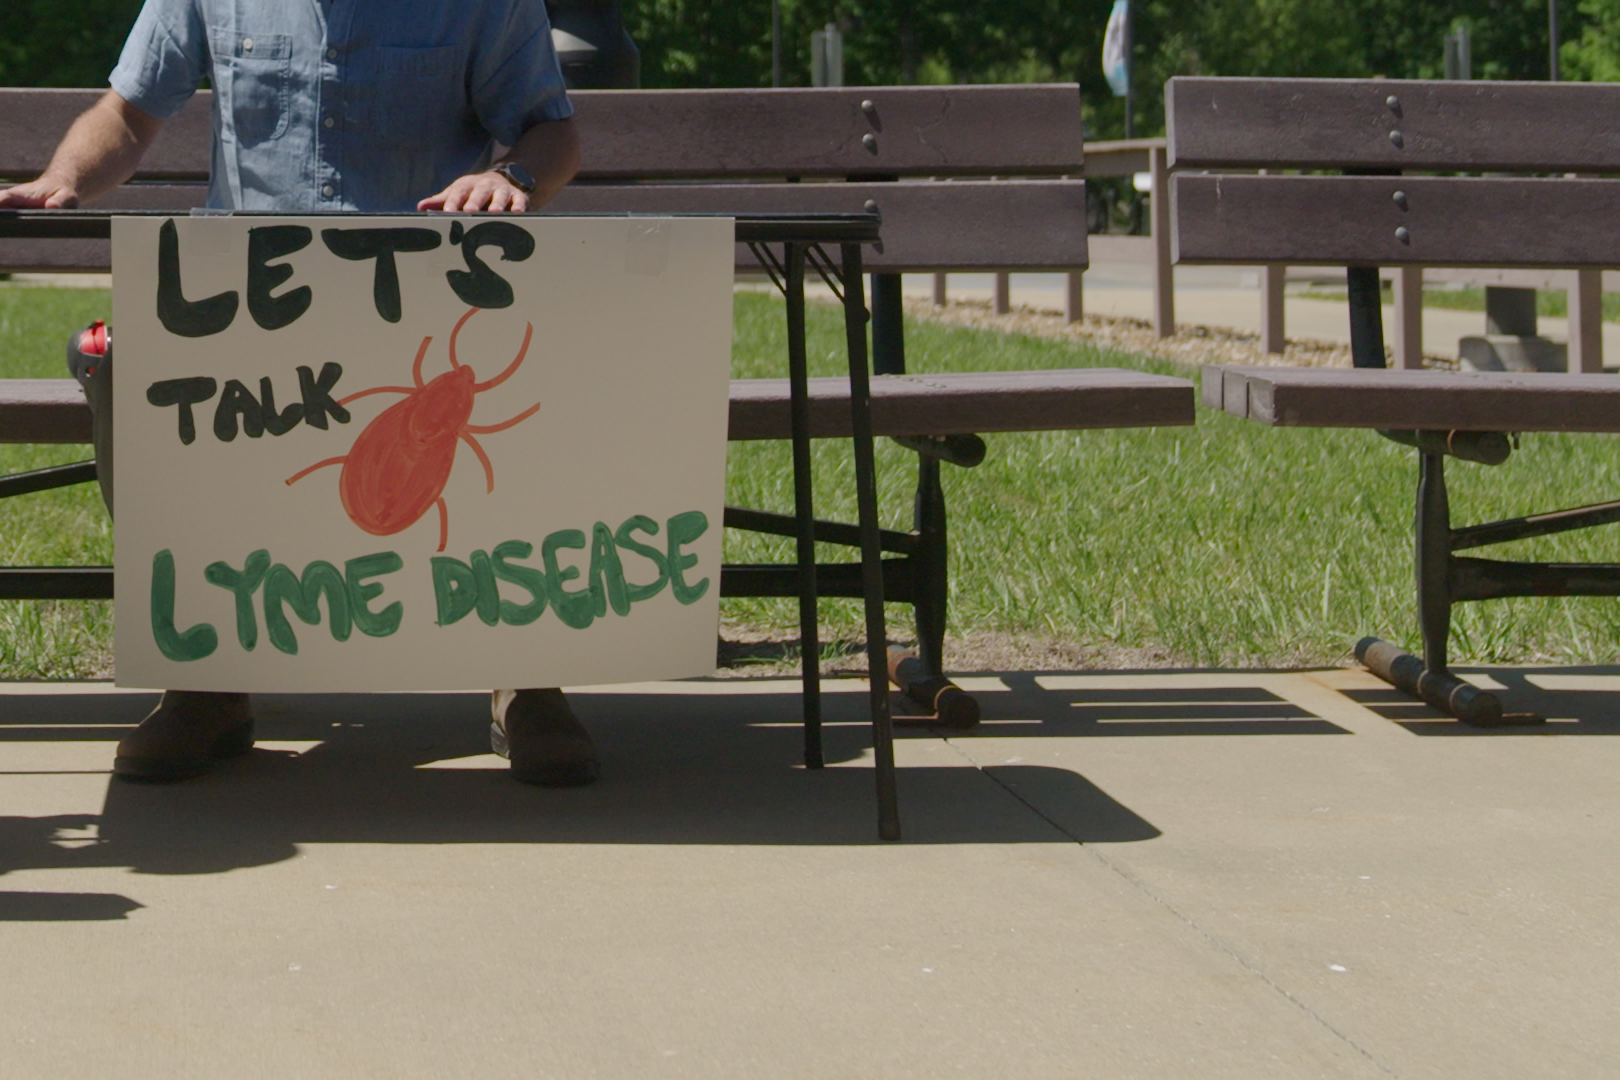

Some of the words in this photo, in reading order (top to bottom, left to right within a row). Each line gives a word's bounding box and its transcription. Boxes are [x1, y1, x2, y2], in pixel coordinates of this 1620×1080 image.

[156, 217, 535, 337] LET'S
[146, 361, 351, 445] TALK
[151, 548, 404, 662] LYME
[430, 510, 710, 630] DISEASE
